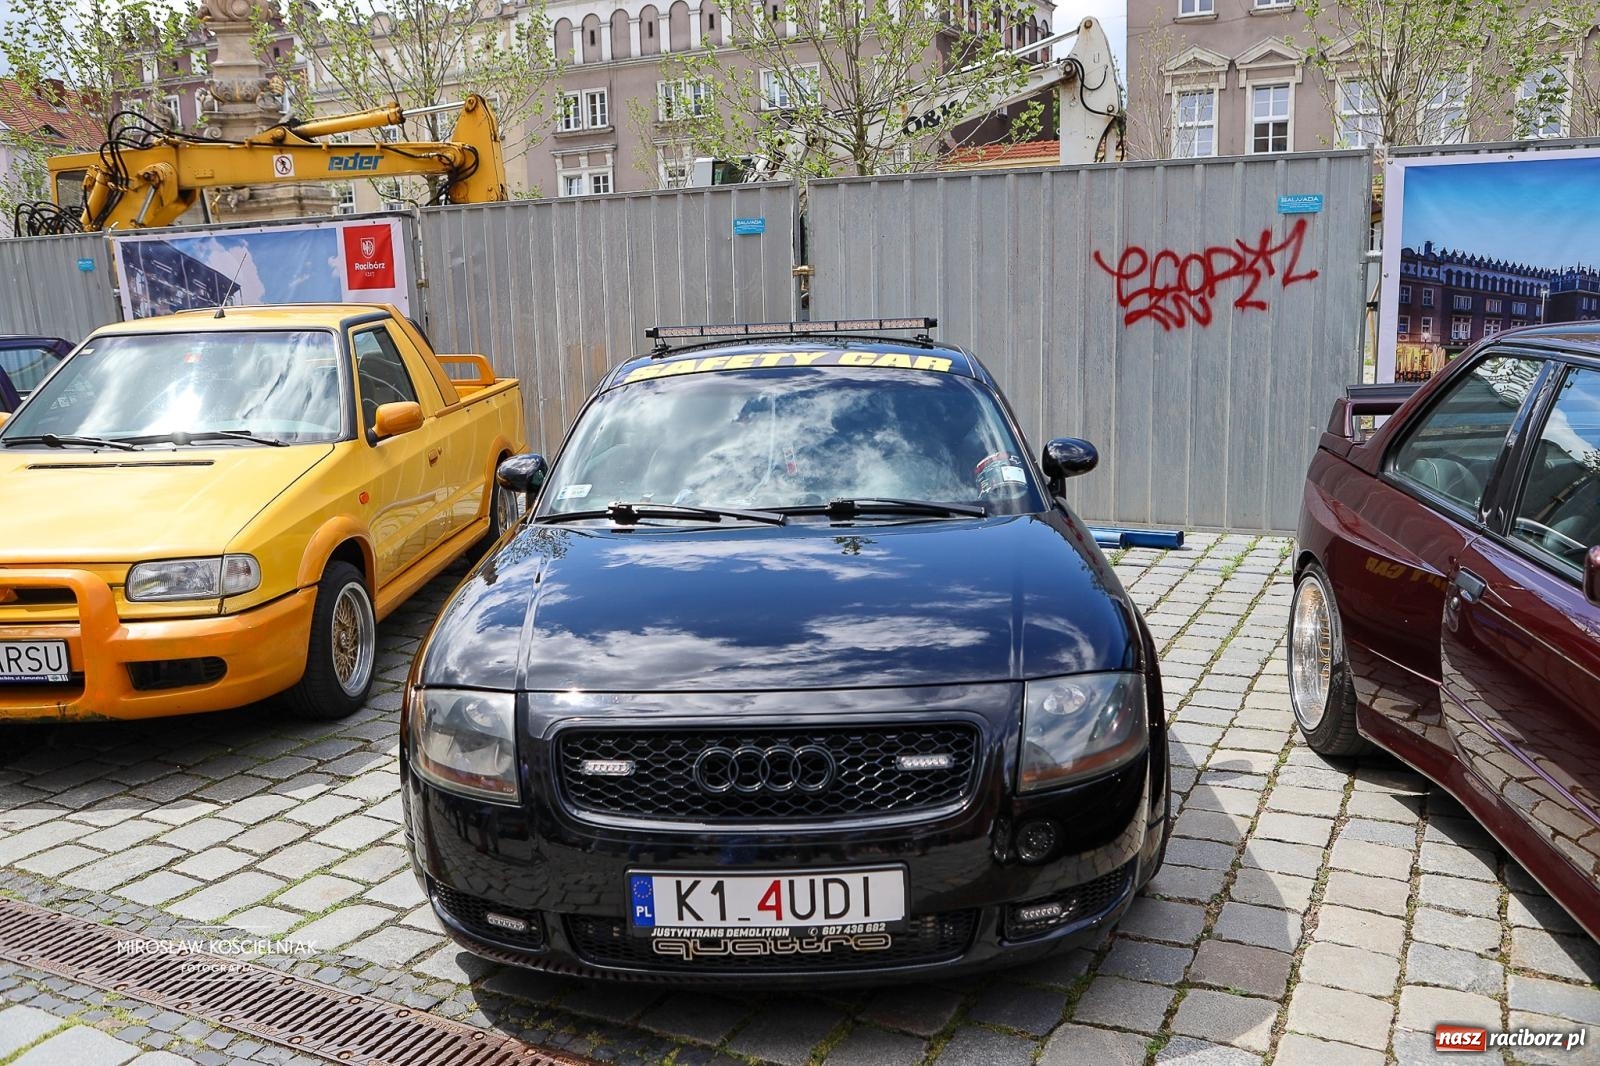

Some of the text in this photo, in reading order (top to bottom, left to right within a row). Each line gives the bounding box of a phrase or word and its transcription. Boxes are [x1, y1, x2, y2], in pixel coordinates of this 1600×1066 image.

[328, 152, 384, 170] eder
[354, 261, 386, 271] Racibórz
[623, 351, 953, 383] SAFETY CAR
[0, 646, 63, 672] RSU
[636, 906, 652, 917] PL
[651, 927, 724, 938] JUSTYNTRANS
[726, 927, 790, 938] DEMOLITION
[652, 934, 892, 961] quattro
